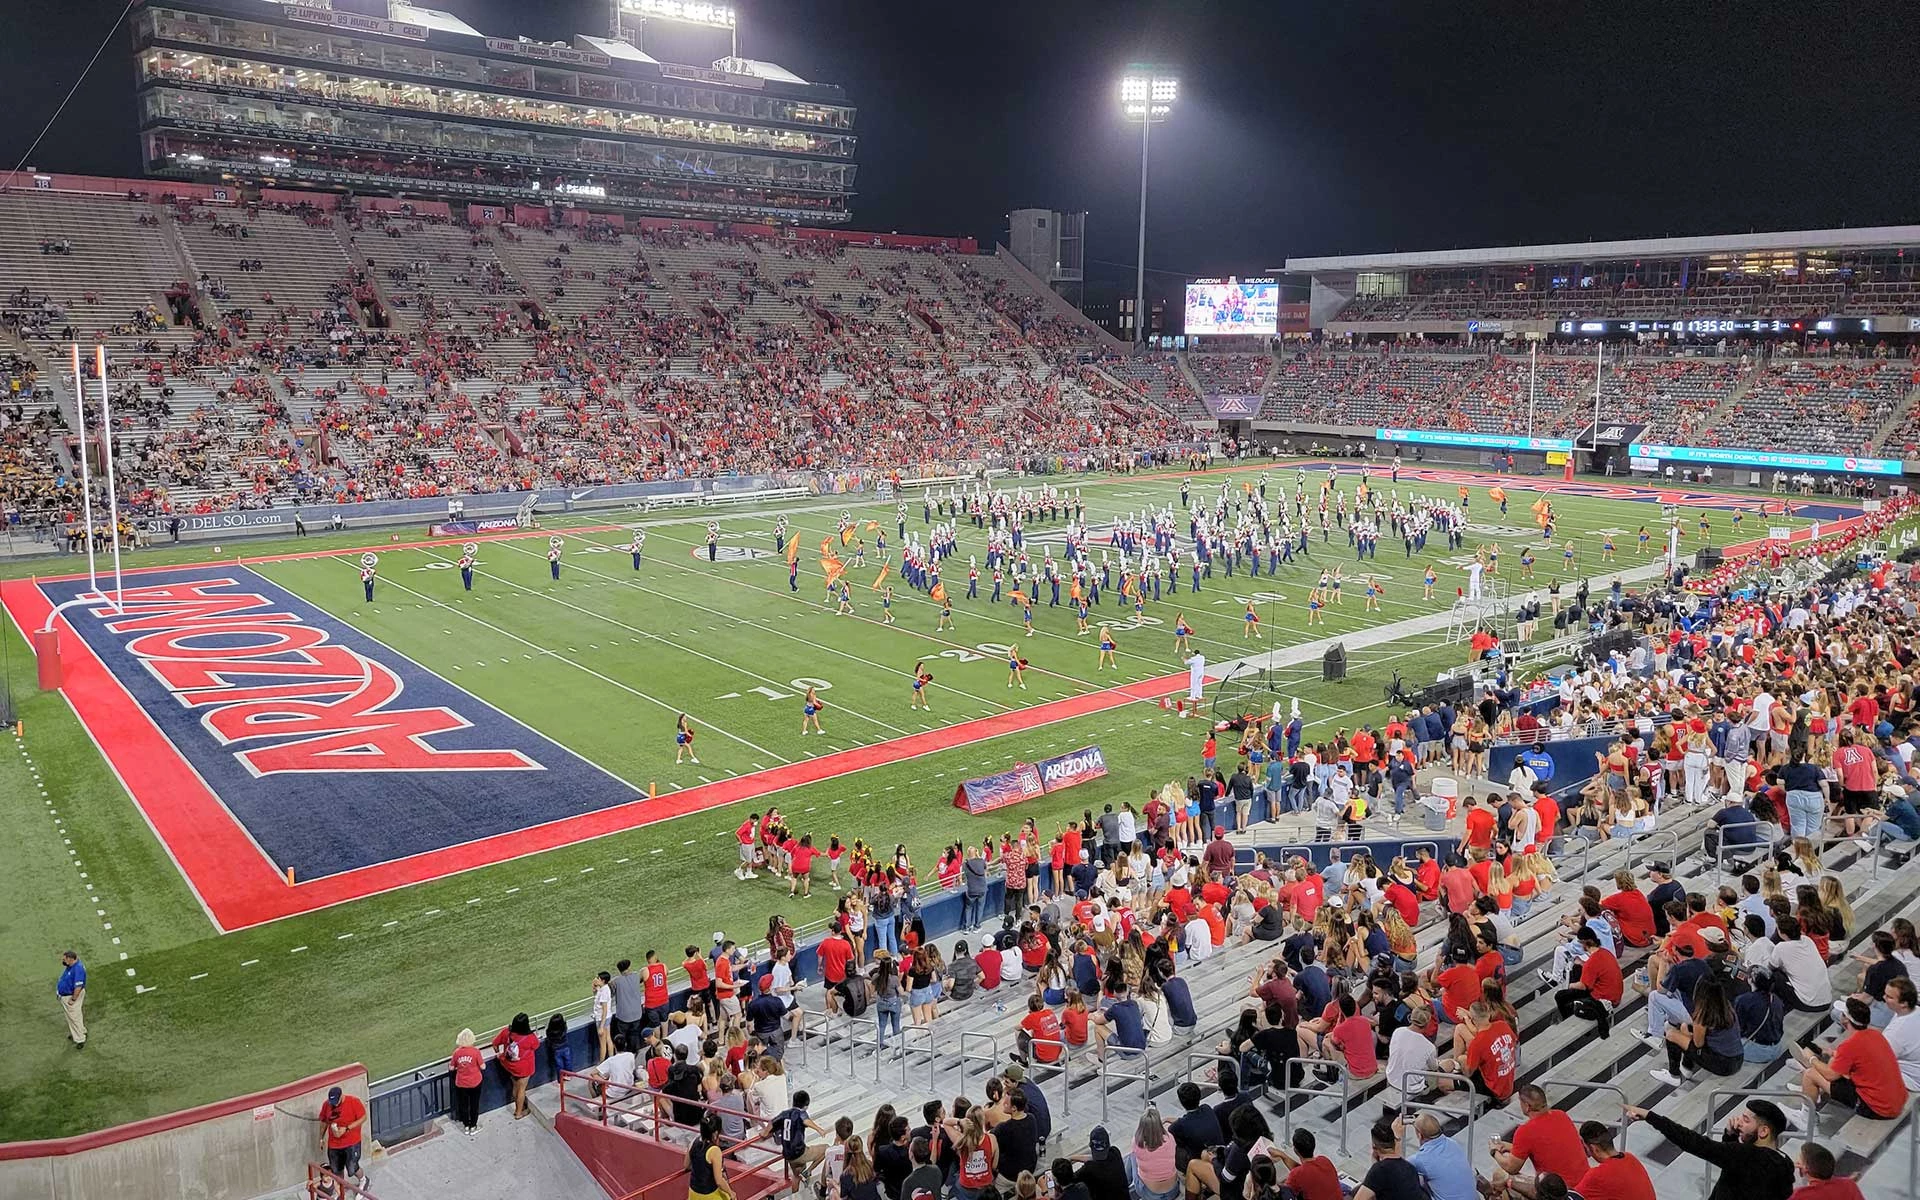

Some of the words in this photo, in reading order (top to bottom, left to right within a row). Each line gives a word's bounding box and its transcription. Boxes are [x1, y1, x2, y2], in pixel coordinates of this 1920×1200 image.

[286, 7, 297, 16] 22
[299, 9, 332, 21] LUPPINO
[337, 16, 348, 24] 89
[350, 18, 380, 29] HUNLEY
[403, 27, 423, 36] CECIL
[497, 41, 514, 50] LEWIS
[36, 180, 49, 188] 18
[215, 191, 226, 200] 19
[484, 210, 493, 218] 21
[1561, 322, 1572, 332] 13
[1628, 322, 1636, 332] 3
[1672, 322, 1682, 331] 10
[1688, 321, 1717, 332] 17:35
[1720, 321, 1733, 331] 20
[1752, 321, 1759, 331] 3
[1771, 321, 1779, 331] 3
[1217, 396, 1252, 413] A
[192, 516, 221, 529] DEL
[223, 513, 282, 527] SOL.com
[478, 518, 517, 529] ARIZONA
[937, 641, 1023, 663] 20
[82, 577, 548, 778] ARIZONA
[746, 677, 834, 700] 10
[1844, 747, 1864, 766] A
[1020, 771, 1039, 793] A
[1045, 750, 1104, 782] ARIZONA
[652, 972, 664, 988] 16
[1490, 1036, 1504, 1056] GET
[783, 1118, 792, 1142] 8
